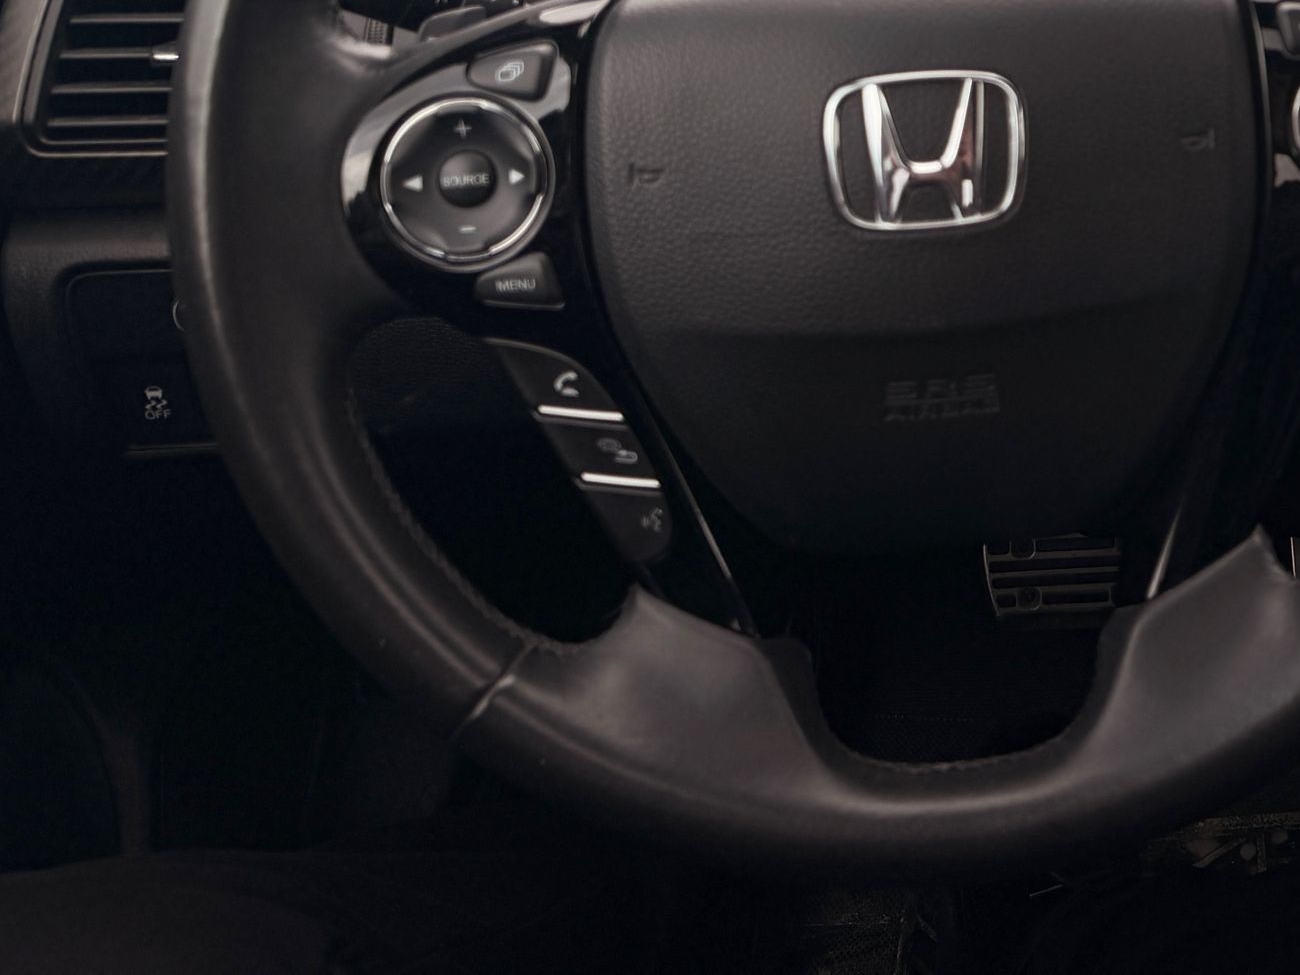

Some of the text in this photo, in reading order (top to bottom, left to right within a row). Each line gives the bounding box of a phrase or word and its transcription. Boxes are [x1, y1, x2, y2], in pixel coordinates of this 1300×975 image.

[442, 173, 490, 187] SOURCE
[494, 277, 536, 292] MENU
[144, 409, 172, 420] OFF
